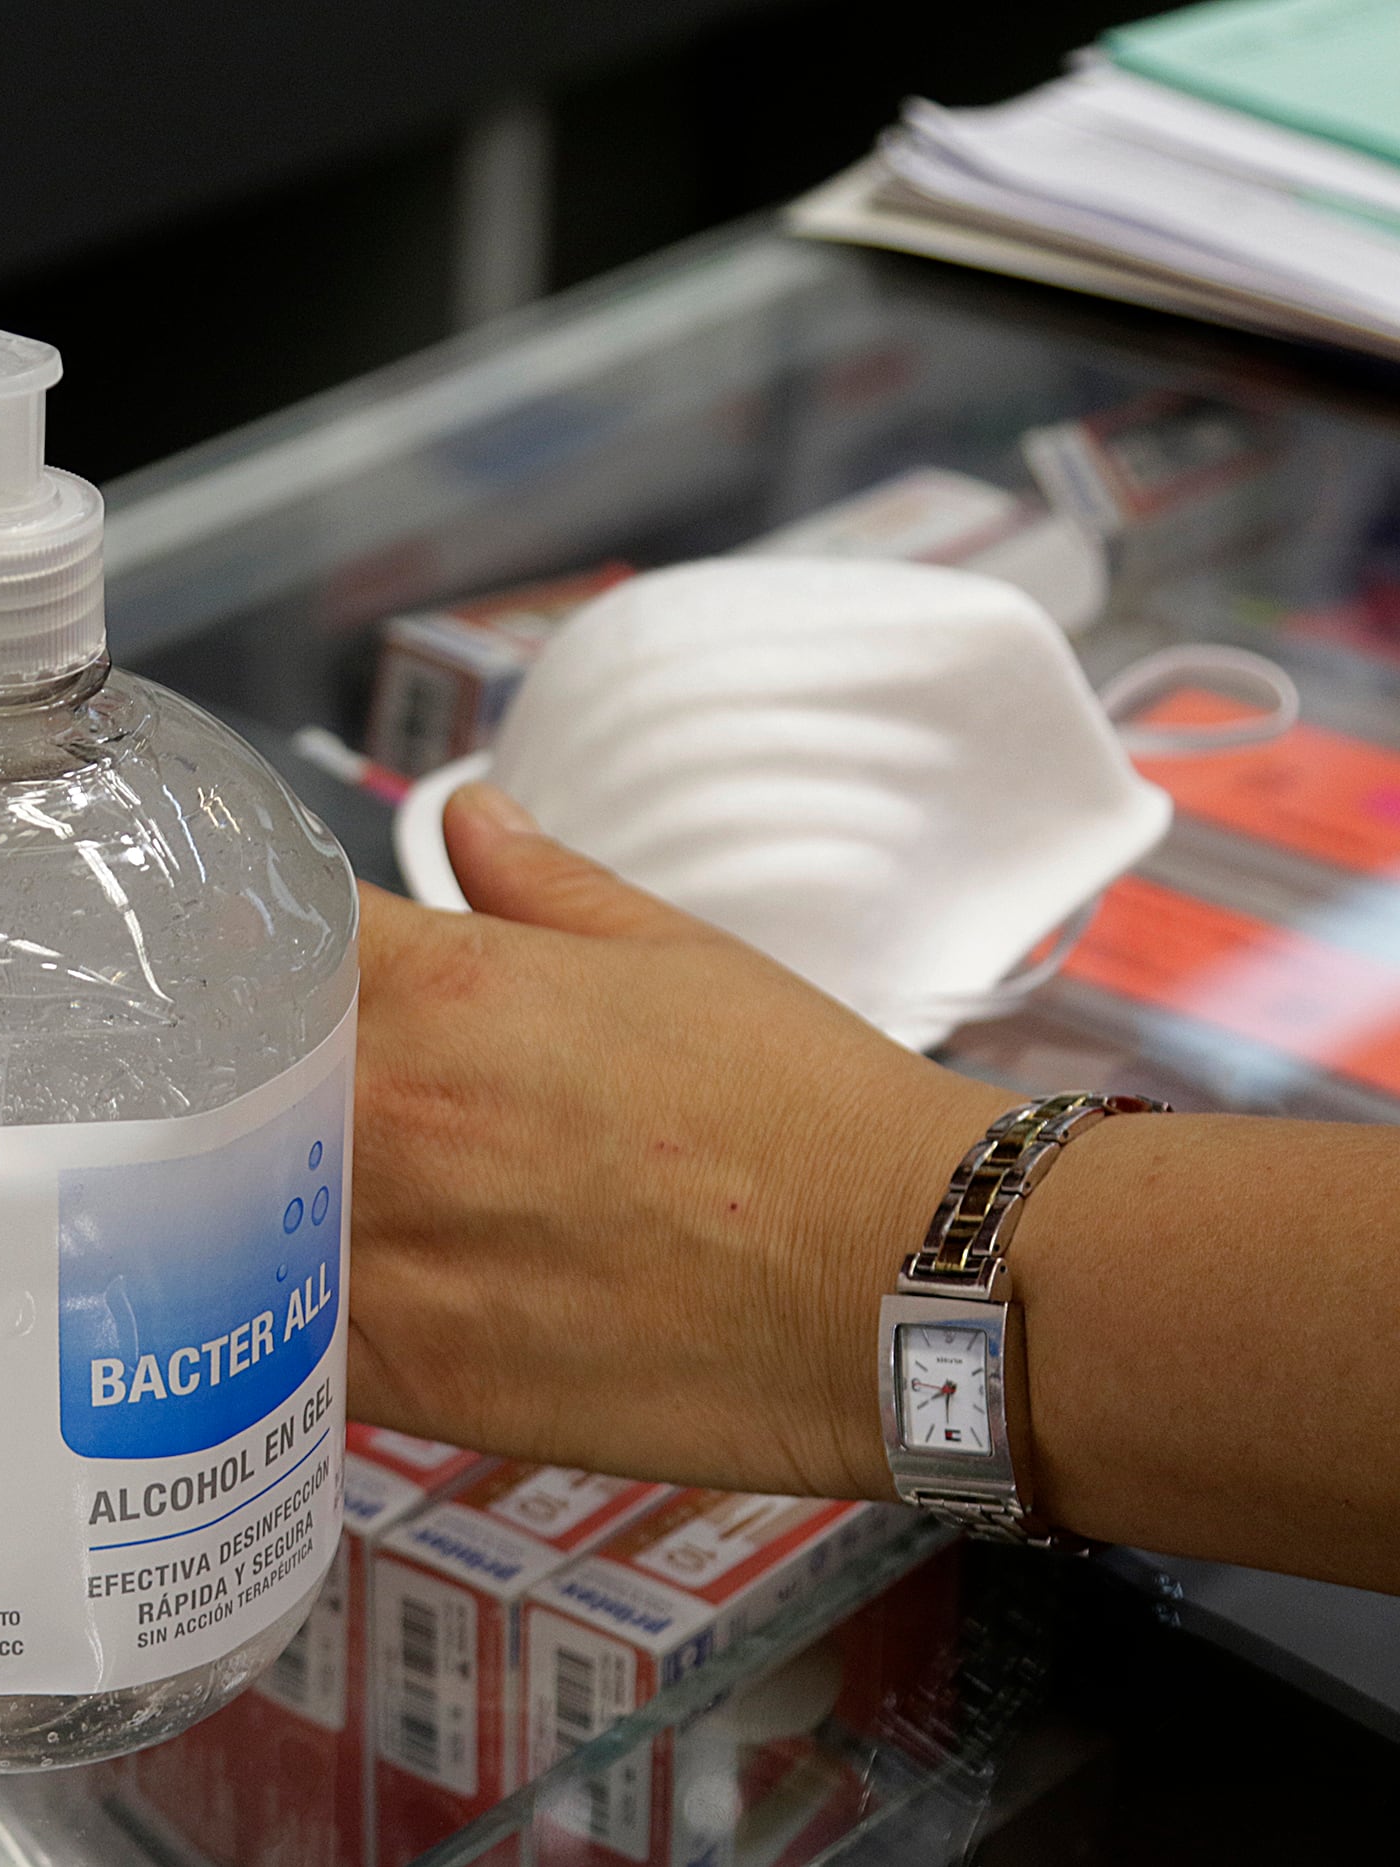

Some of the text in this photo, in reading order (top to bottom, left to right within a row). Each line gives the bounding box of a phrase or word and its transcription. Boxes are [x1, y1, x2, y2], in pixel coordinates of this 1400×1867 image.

[91, 1262, 332, 1408] BACTER ALL
[88, 1376, 334, 1526] ALCOHOL EN GEL
[87, 1552, 211, 1598] EFECTIVA
[219, 1455, 330, 1565] DESINFECCIÓN
[137, 1538, 314, 1649] SIN ACCIÓN TERAPÉUTICA
[138, 1509, 314, 1625] RÁPIDA Y SEGURA
